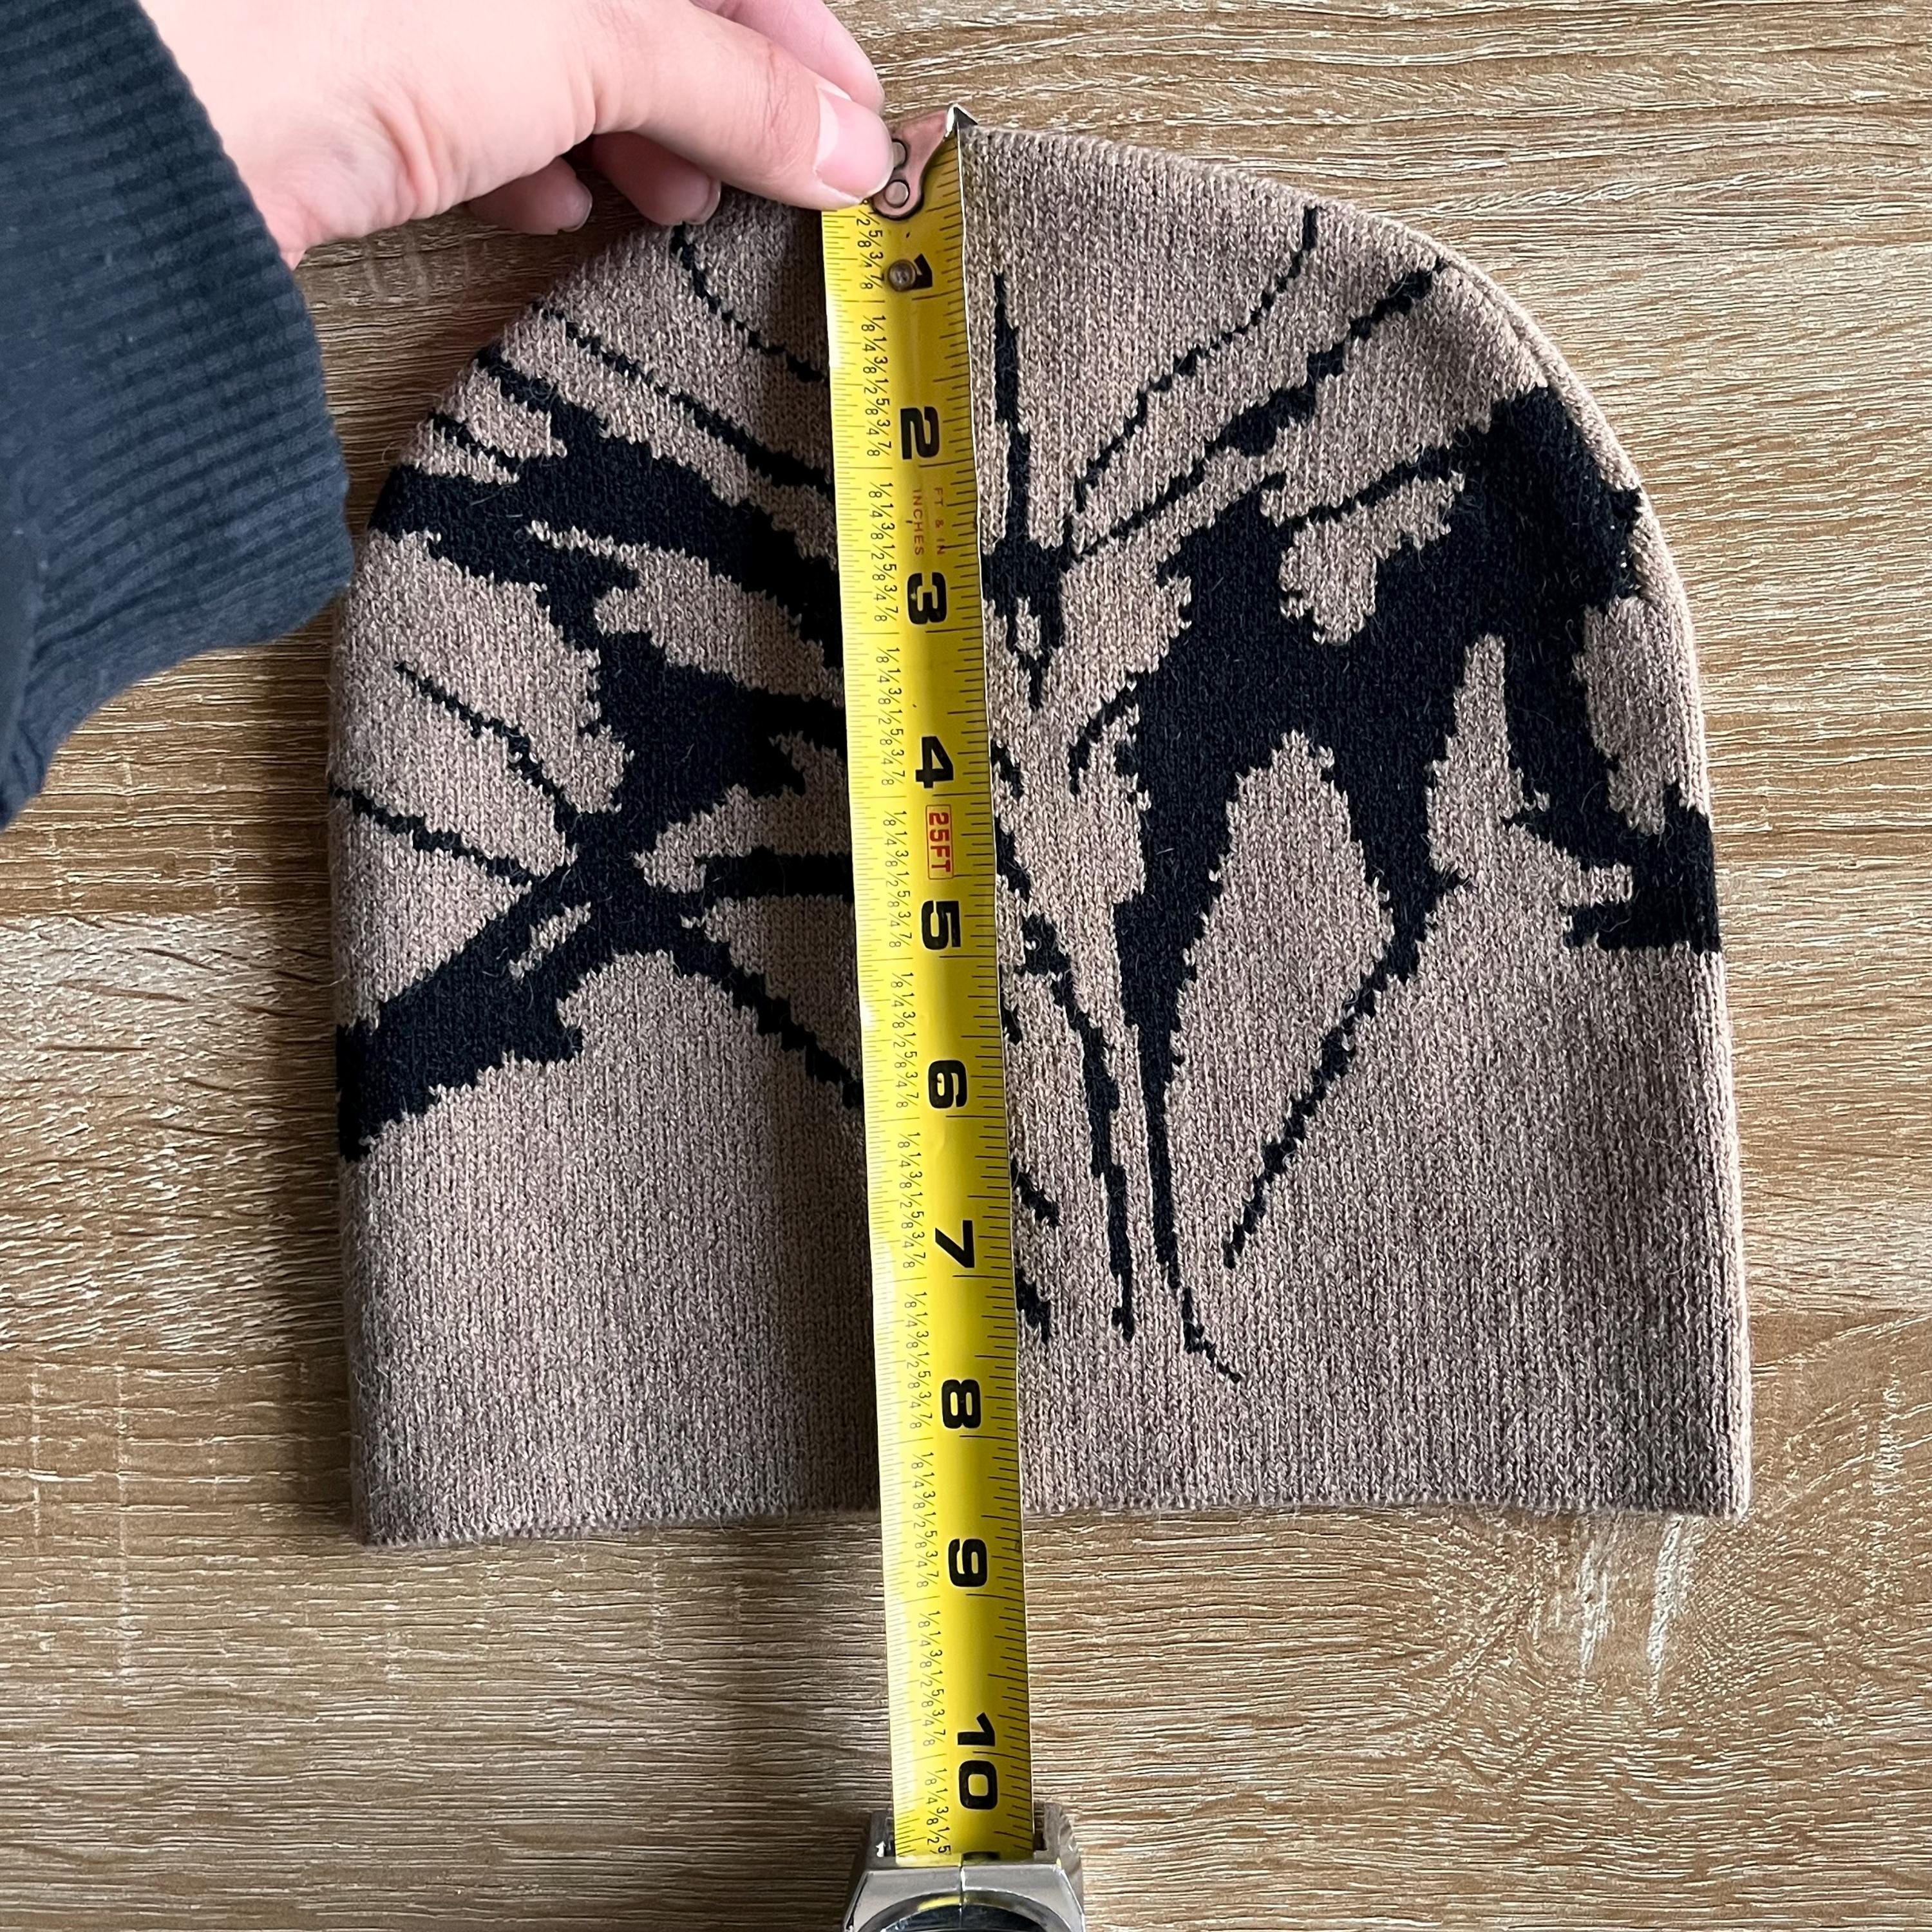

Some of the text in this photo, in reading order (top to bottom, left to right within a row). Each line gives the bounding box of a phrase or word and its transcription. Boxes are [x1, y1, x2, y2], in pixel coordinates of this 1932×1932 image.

[857, 230, 882, 247] 5/8
[861, 274, 884, 289] 7/8
[862, 315, 891, 456] 1/8 1/4 3/8 1/2 5/8 3/4 7/8
[900, 406, 940, 459] 2
[913, 489, 923, 555] INCHES
[934, 487, 945, 555] FT & IN
[869, 482, 898, 621] 1/8 1/4 3/8 1/2 5/8 3/4 7/8
[907, 572, 947, 625] 3
[876, 647, 905, 785] 1/8 1/4 3/8 1/2 5/8 3/4 7/8
[916, 736, 954, 788] 4
[929, 812, 951, 873] 25FT
[884, 811, 912, 947] 1/8 1/4 3/8 1/2 5/8 3/4 7/8
[921, 901, 961, 950] 5
[891, 972, 918, 1108] 1/8 1/4 3/8 1/2 5/8 3/4 7/8
[928, 1059, 967, 1109] 6
[898, 1132, 925, 1267] 1/8 1/4 3/8 1/2 5/8 3/4 7/8
[935, 1220, 974, 1268] 7
[905, 1292, 933, 1428] 1/8 1/4 3/8 1/2 5/8 3/4 7/8
[942, 1379, 981, 1429] 8
[912, 1452, 939, 1587] 1/8 1/4 3/8 1/2 5/8 3/4 7/8
[948, 1539, 988, 1587] 9
[918, 1611, 945, 1747] 1/8 1/4 3/8 1/2 5/8 3/4 7/8
[925, 1768, 947, 1785] 1/8
[957, 1712, 998, 1810] 10
[925, 1788, 948, 1804] 1/4
[927, 1806, 949, 1825] 3/8
[927, 1827, 950, 1845] 1/2
